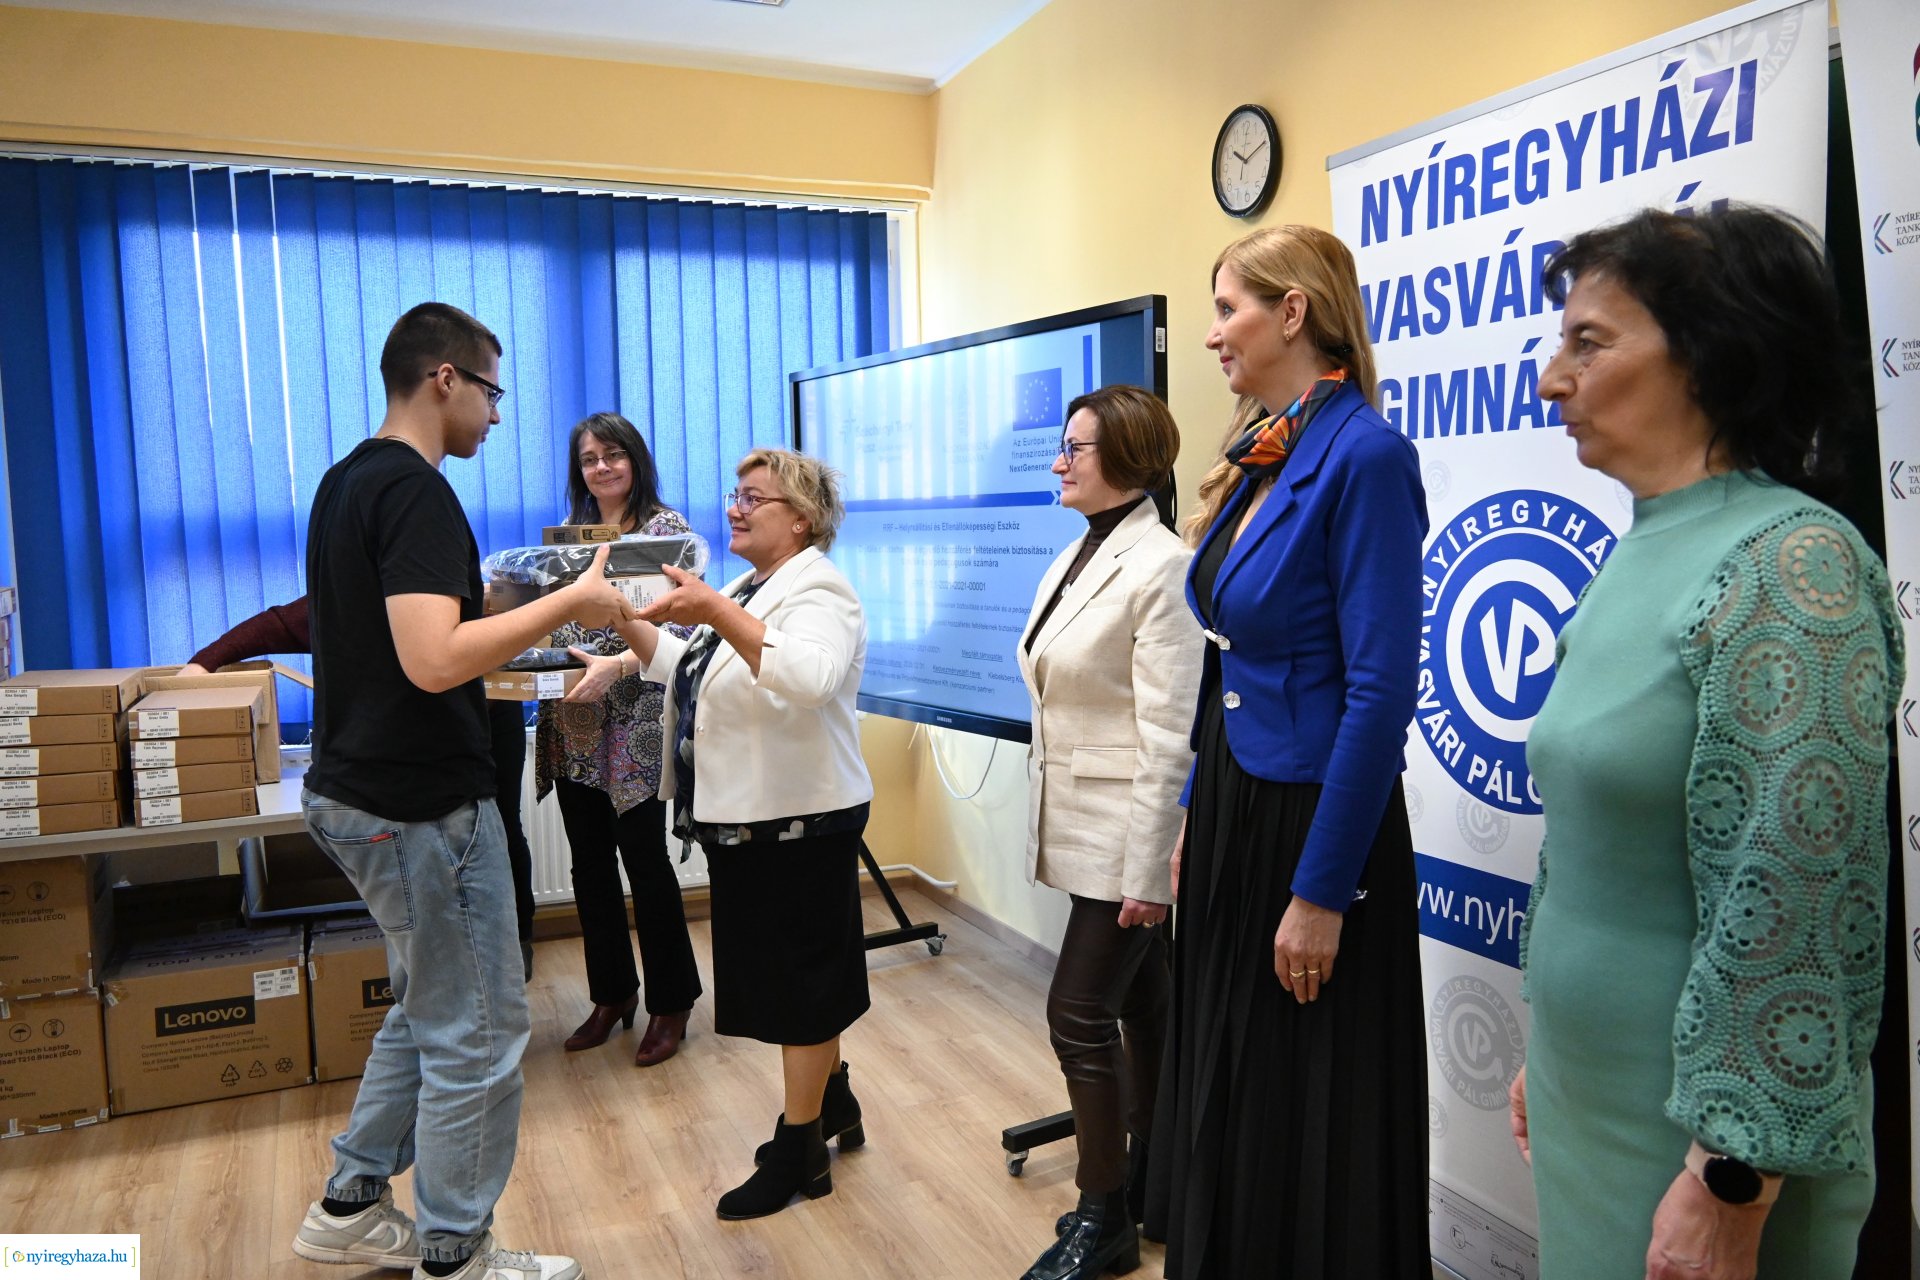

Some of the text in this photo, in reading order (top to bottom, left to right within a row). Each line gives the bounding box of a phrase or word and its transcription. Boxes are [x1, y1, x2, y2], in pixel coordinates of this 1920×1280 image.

[1361, 58, 1758, 247] NYÍREGYHÁZI
[1012, 438, 1021, 447] Az
[997, 520, 1020, 531] Eszköz
[1011, 544, 1047, 556] biztosítása
[973, 557, 999, 568] számára
[43, 912, 66, 921] (ECO)
[165, 1003, 247, 1030] Lenovo
[60, 1048, 82, 1058] (ECO)
